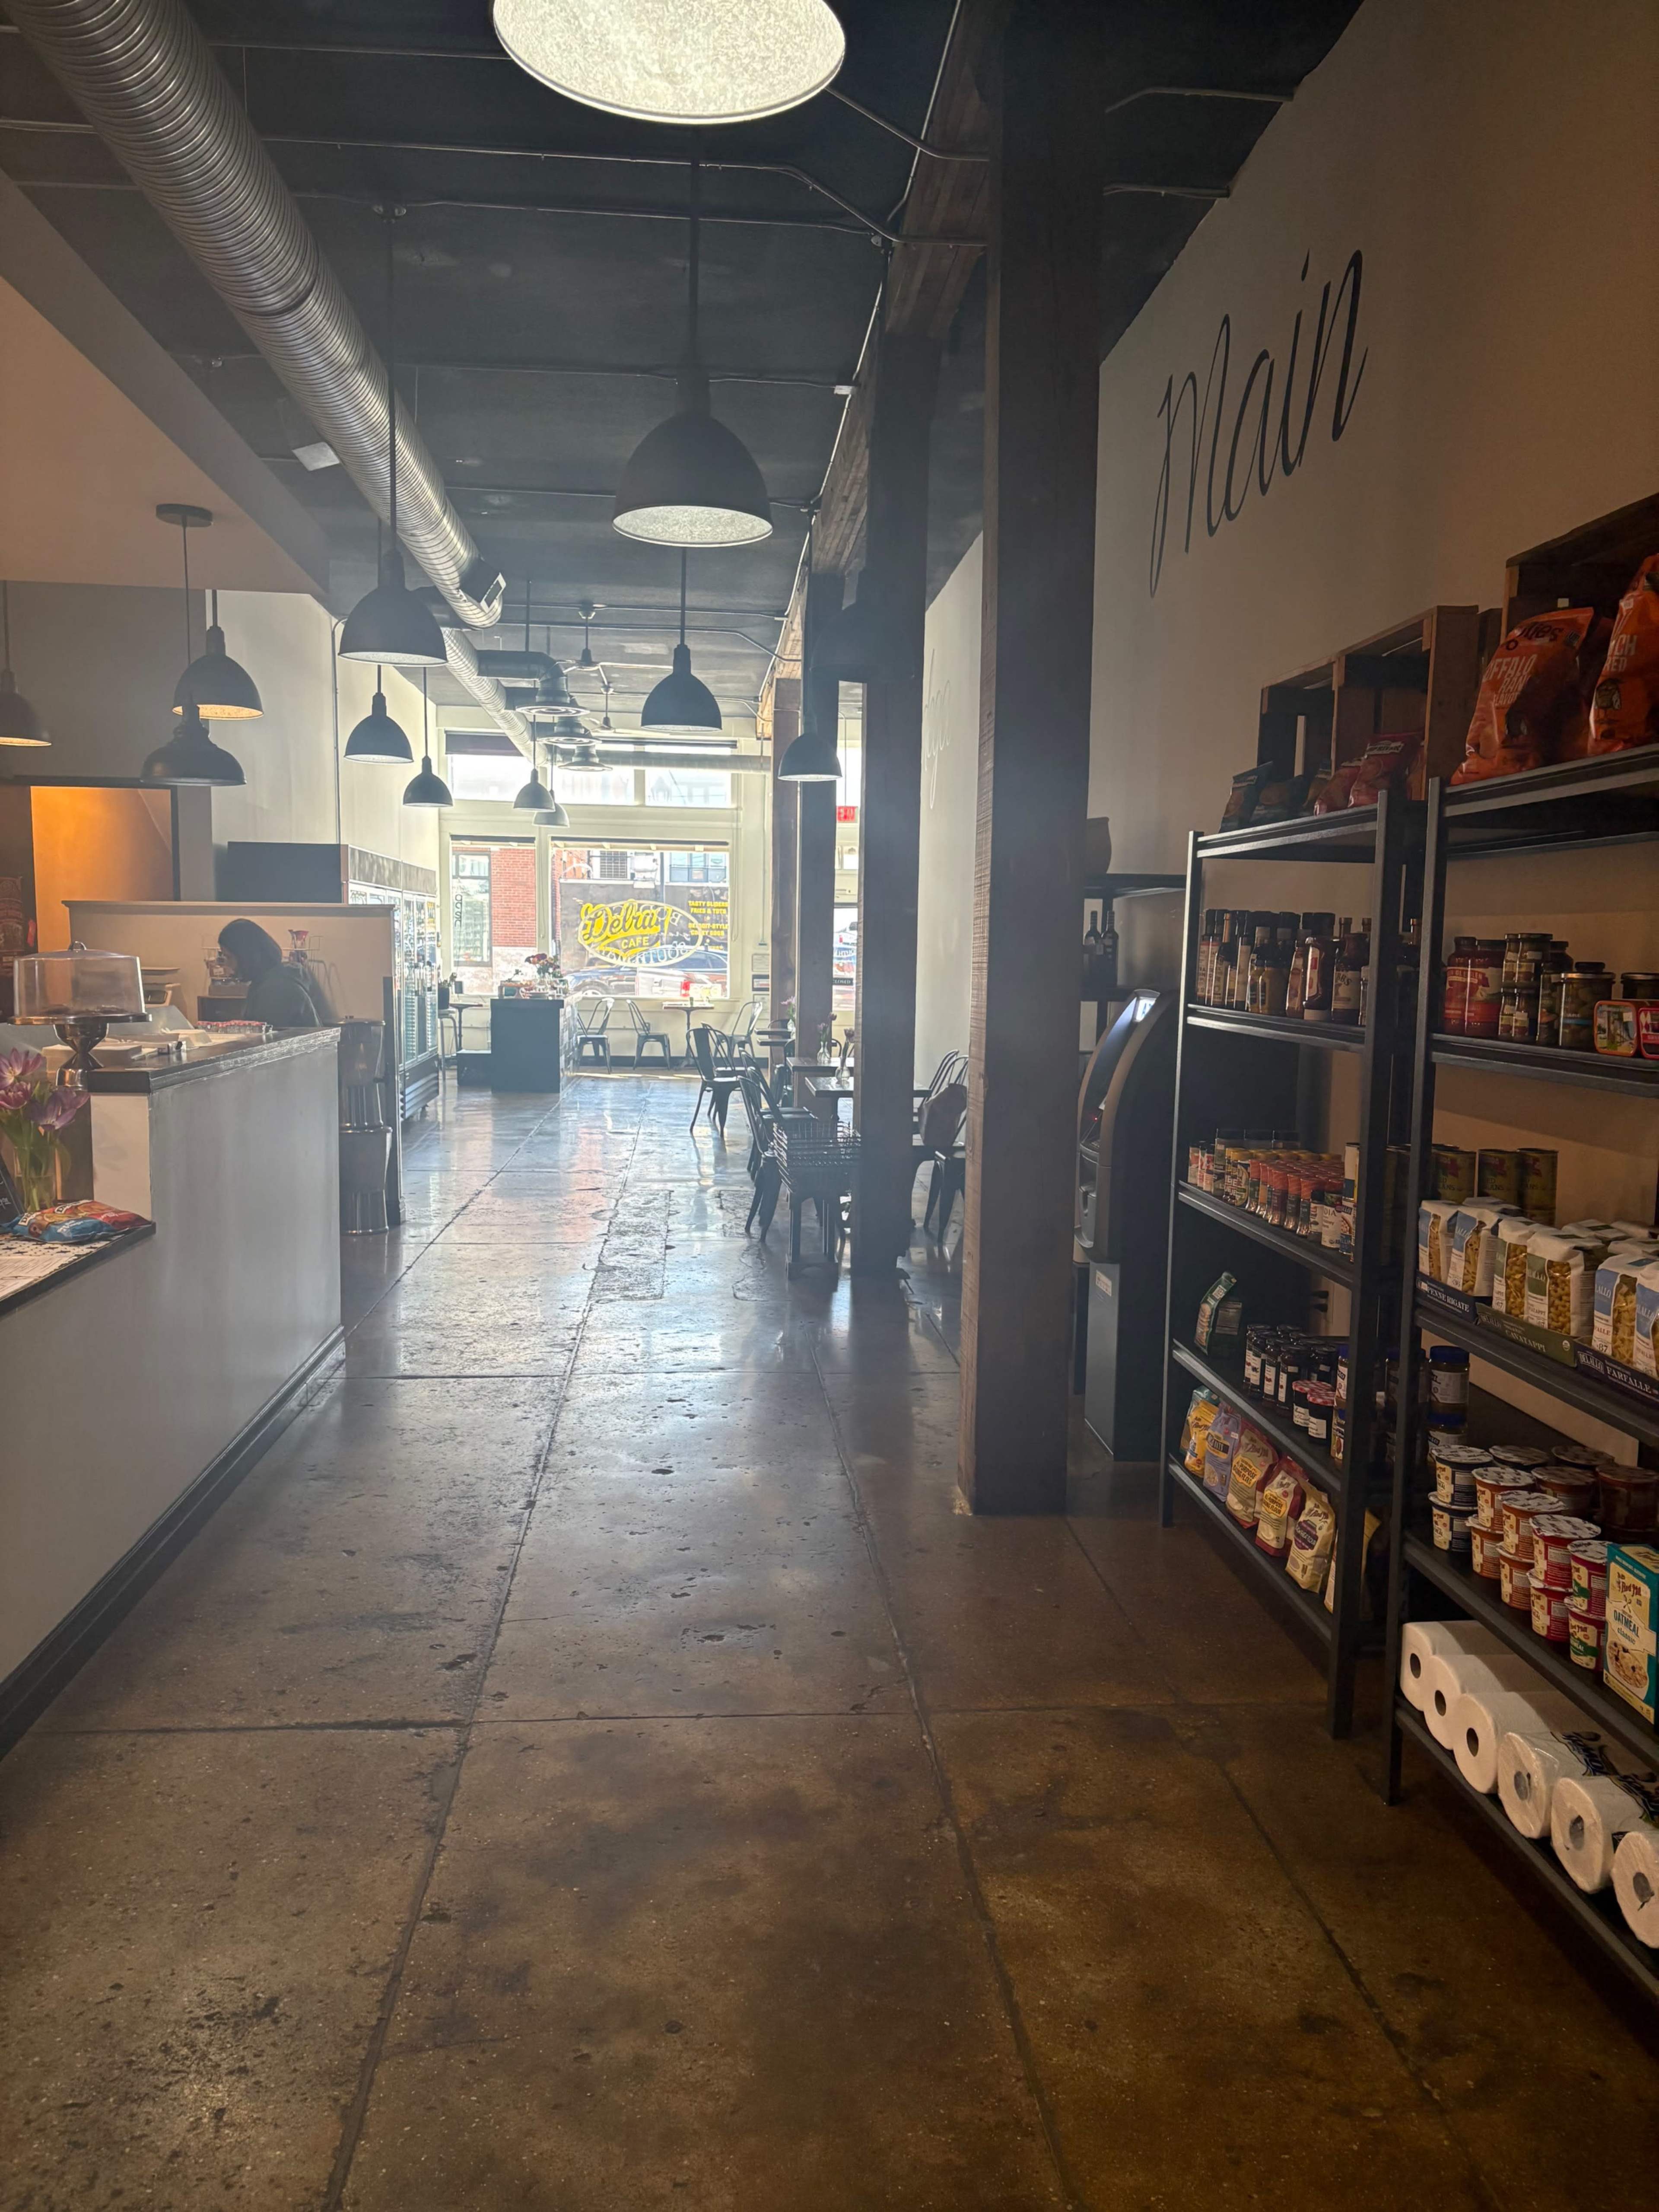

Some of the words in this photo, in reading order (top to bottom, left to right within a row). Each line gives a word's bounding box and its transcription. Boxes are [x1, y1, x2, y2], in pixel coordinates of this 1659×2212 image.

[621, 936, 649, 949] CAFE
[1427, 1286, 1446, 1302] PENNE
[1446, 1295, 1469, 1312] RIGATE
[1505, 1330, 1546, 1353] CAVATAPPI
[1606, 1365, 1653, 1394] FARFALLE
[1614, 1610, 1640, 1638] OATMEAL
[1617, 1627, 1636, 1645] classic
